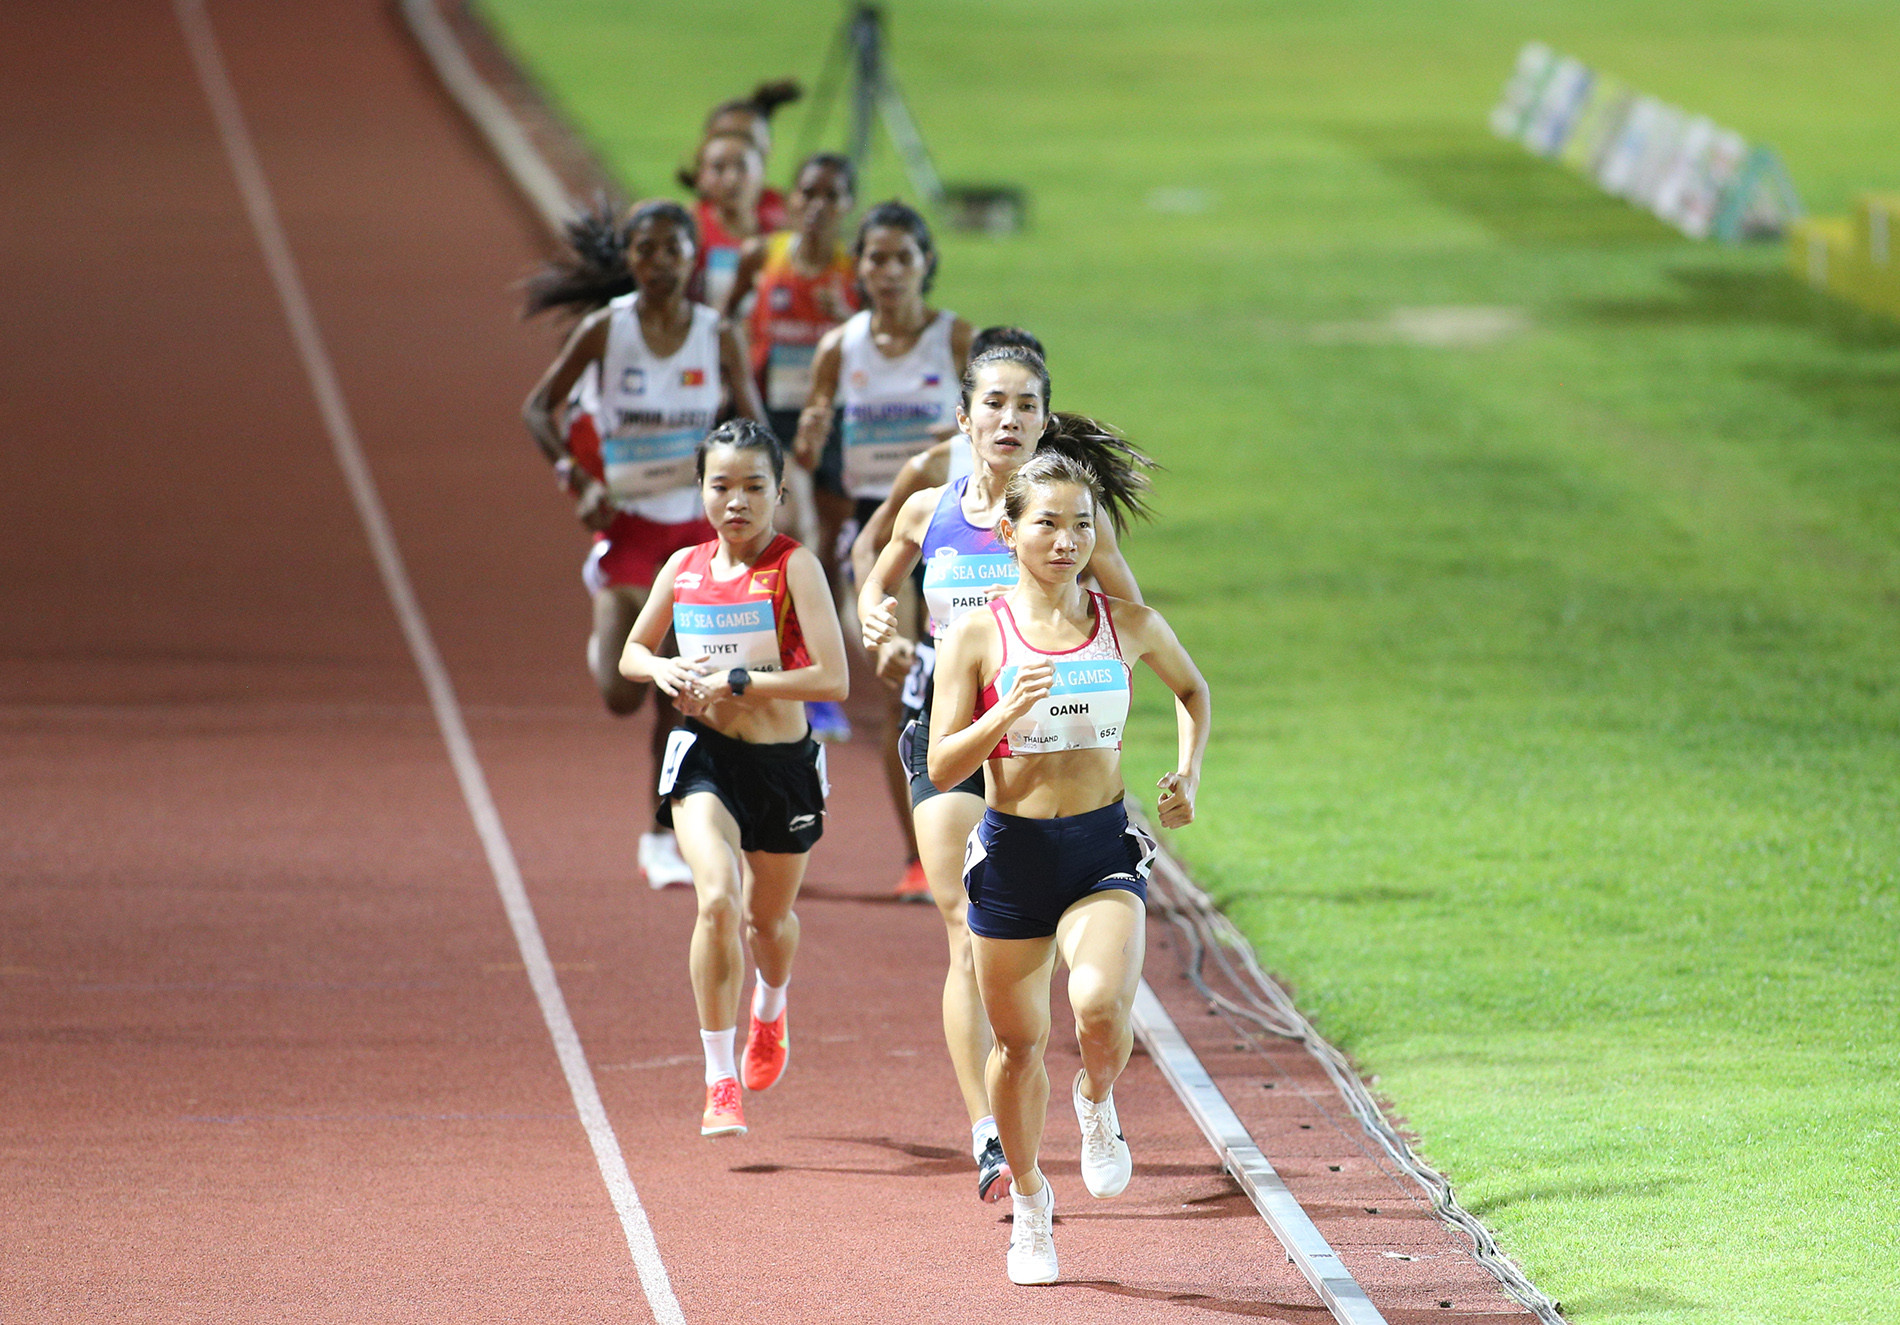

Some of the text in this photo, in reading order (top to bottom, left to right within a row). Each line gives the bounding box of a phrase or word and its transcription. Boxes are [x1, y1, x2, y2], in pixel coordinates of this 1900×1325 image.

[953, 565, 976, 580] SEA
[694, 613, 715, 628] SEA
[716, 610, 760, 628] GAMES
[703, 642, 739, 655] TUYET
[1067, 668, 1113, 687] GAMES
[1049, 702, 1090, 717] OANH
[1022, 734, 1060, 744] THAILAND
[1099, 726, 1118, 739] 652
